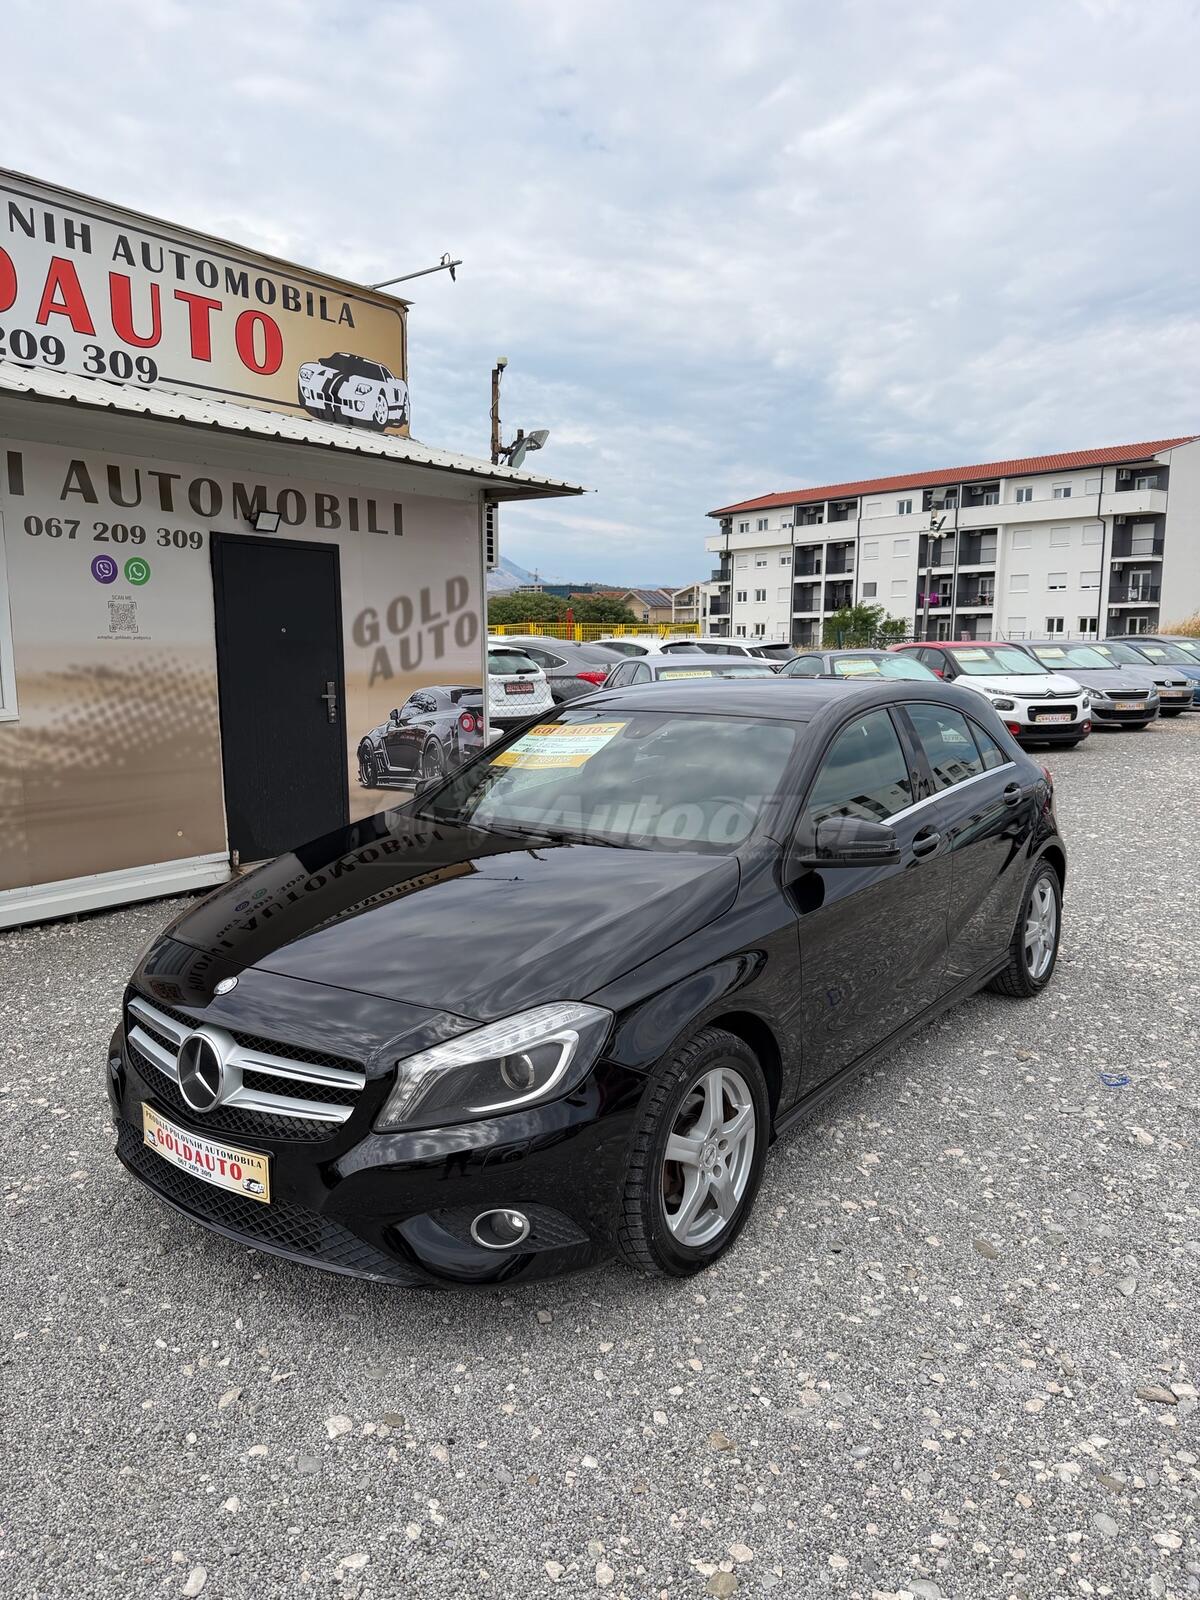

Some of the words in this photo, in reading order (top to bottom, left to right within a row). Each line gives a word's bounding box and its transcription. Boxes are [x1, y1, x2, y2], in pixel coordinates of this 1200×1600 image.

[8, 201, 92, 254] NIH
[112, 234, 356, 329] AUTOMOBILA
[83, 344, 158, 384] 309
[7, 451, 25, 496] I
[60, 459, 404, 537] AUTOMOBILI
[24, 515, 81, 540] 067
[93, 522, 147, 545] 209
[156, 528, 204, 550] 309
[352, 575, 470, 649] GOLD
[368, 610, 479, 689] AUTO
[156, 1128, 243, 1181] GOLDAUTO
[204, 1145, 262, 1169] AUTOMOBILA
